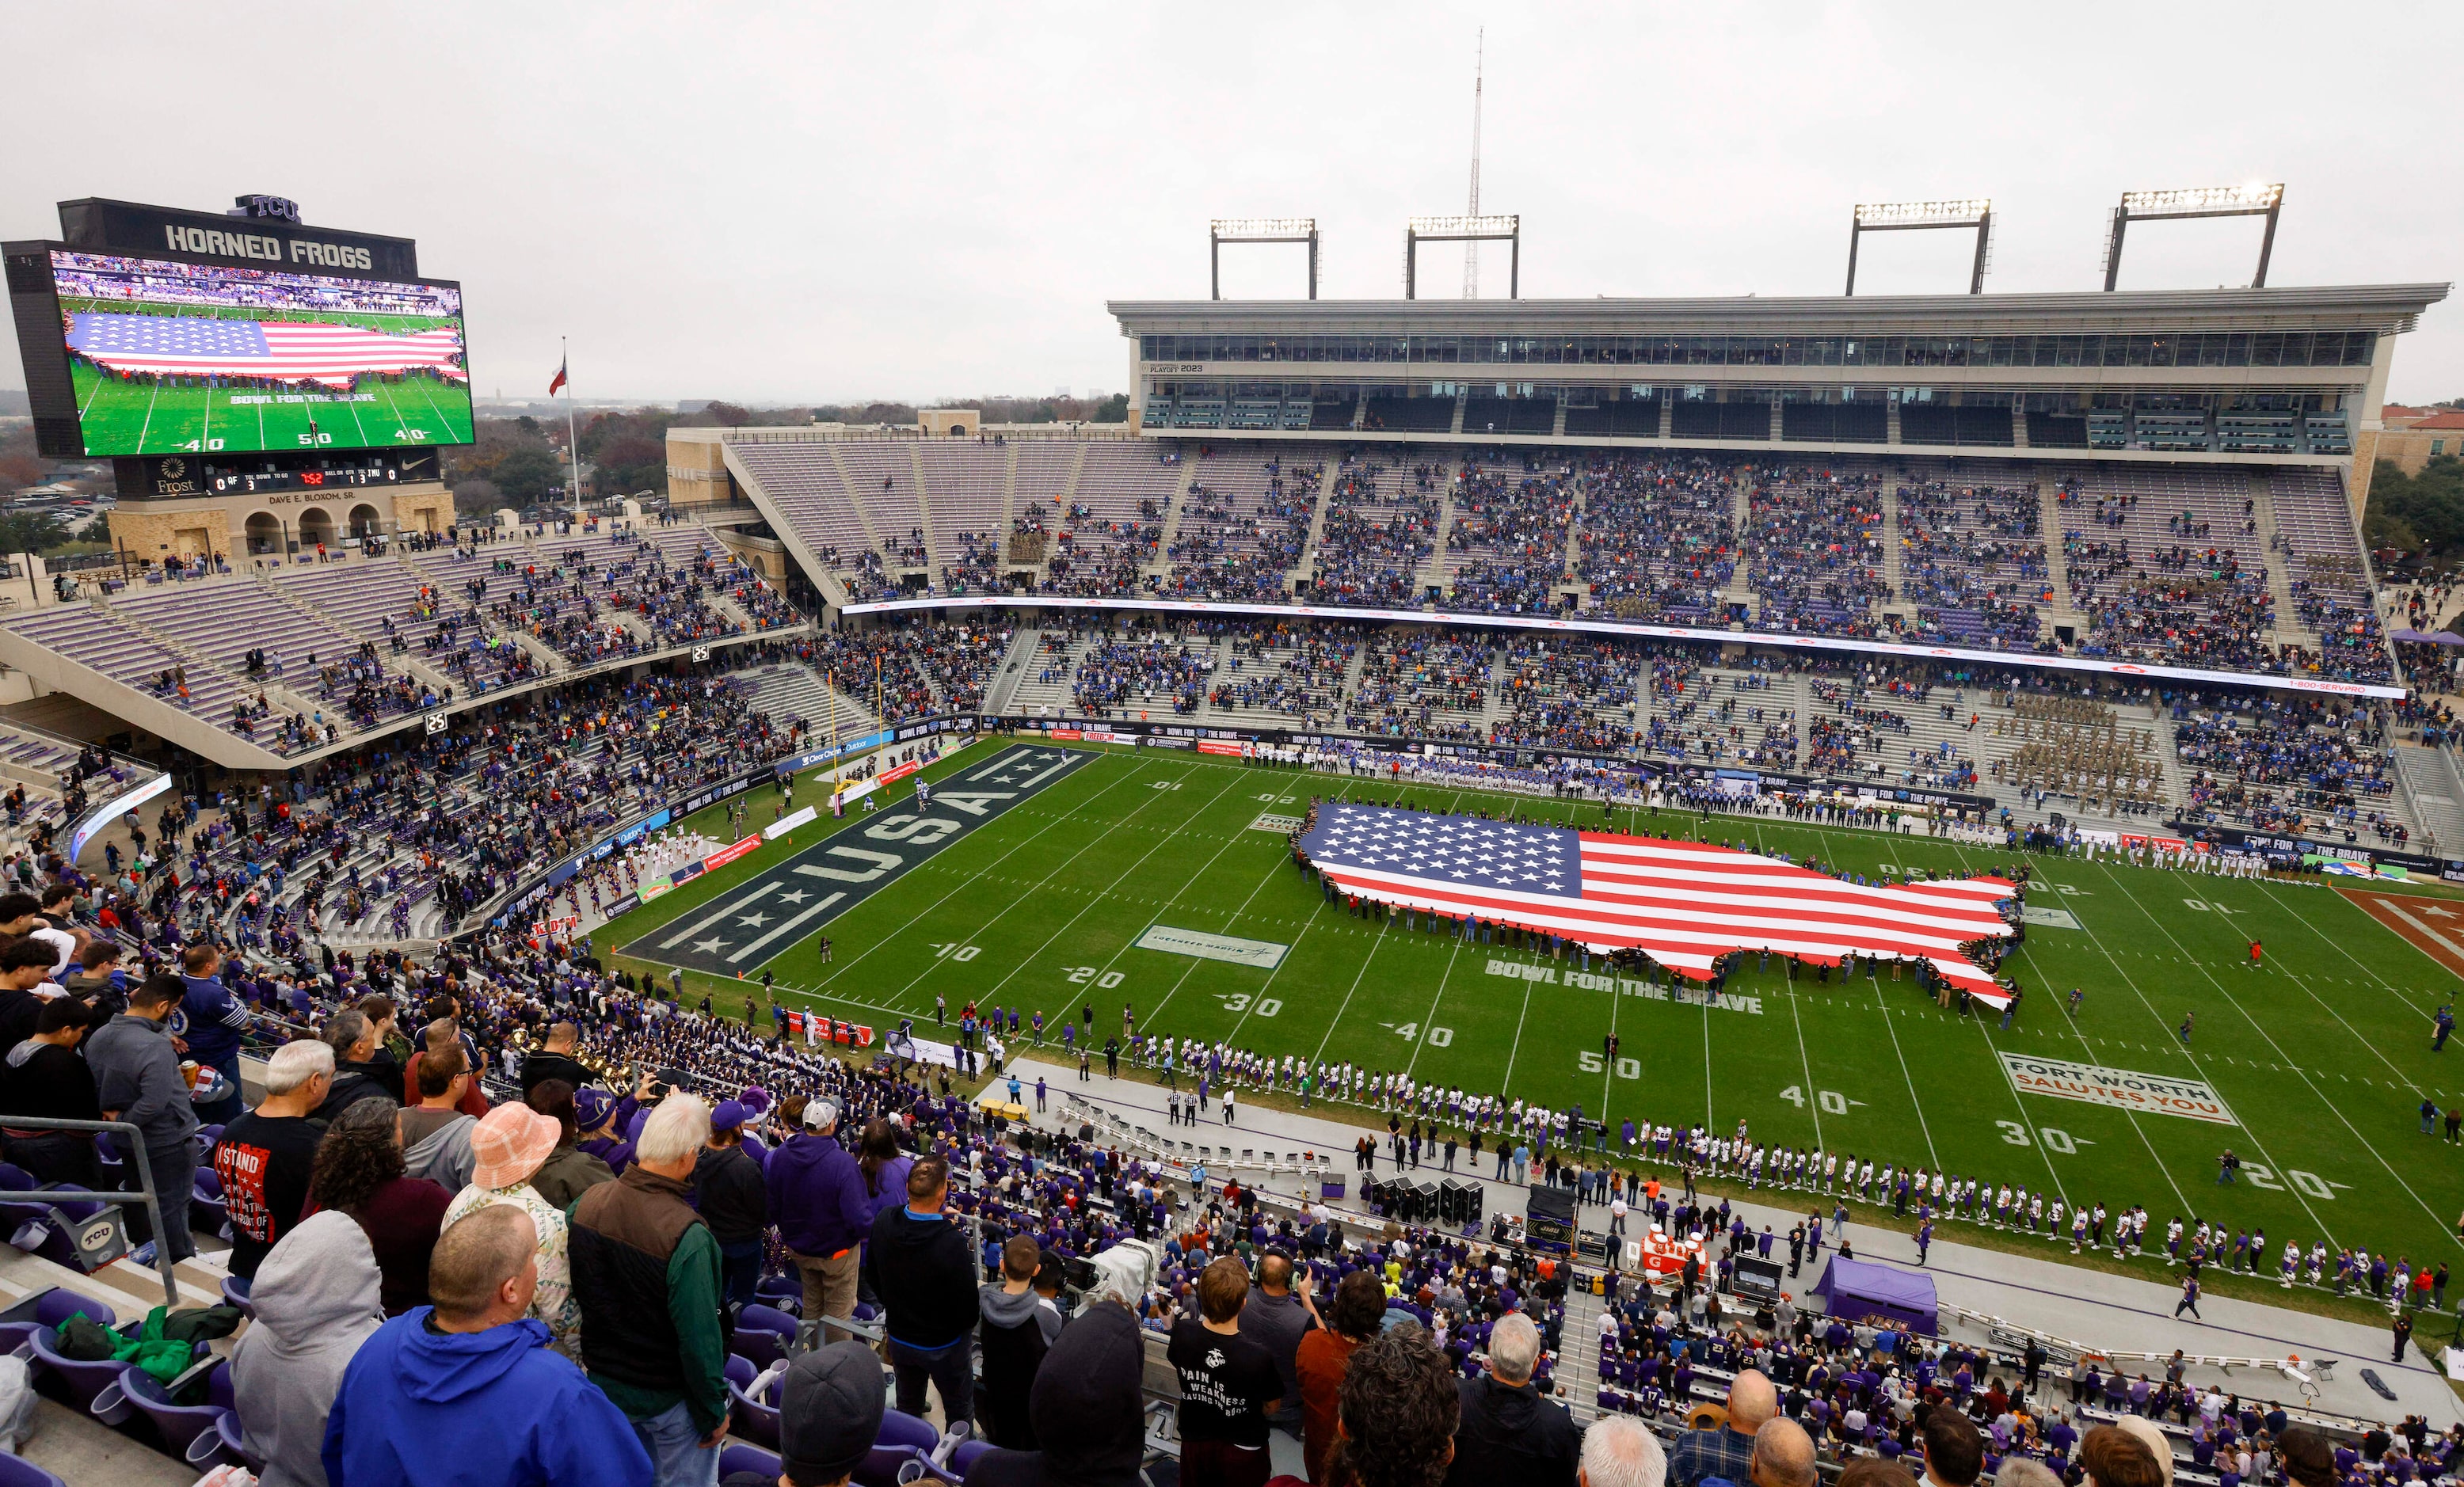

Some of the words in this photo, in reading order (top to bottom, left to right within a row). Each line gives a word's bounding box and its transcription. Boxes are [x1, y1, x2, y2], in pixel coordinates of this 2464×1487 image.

[253, 196, 299, 222] TCU
[166, 225, 281, 261] HORNED
[289, 239, 372, 270] FROGS
[230, 395, 274, 405] BOWL
[277, 394, 306, 403] FOR
[307, 394, 333, 403] THE
[298, 432, 333, 446] 50
[394, 428, 425, 440] 40
[185, 439, 225, 452] 40
[301, 473, 323, 485] 7:52
[360, 475, 366, 484] 3
[367, 468, 380, 478] JMU
[388, 469, 396, 481] 0
[158, 479, 196, 493] Frost
[215, 478, 226, 491] 0
[227, 475, 238, 486] AF
[248, 481, 255, 491] 3
[269, 495, 291, 505] DAVE
[294, 494, 303, 503] E.
[304, 492, 341, 503] BLOXOM,
[343, 491, 356, 500] SR.
[695, 645, 708, 660] 25
[2288, 679, 2366, 694] 1-800-SERVPRO
[428, 716, 445, 731] 25
[899, 728, 916, 740] BOWL
[916, 724, 927, 736] FOR
[939, 720, 951, 730] THE
[1058, 721, 1070, 730] FOR
[1082, 722, 1094, 731] THE
[1093, 723, 1112, 732] BRAVE
[1167, 727, 1184, 736] BOWL
[1183, 728, 1195, 737] FOR
[1208, 729, 1220, 738] THE
[1218, 731, 1238, 740] BRAVE
[1292, 735, 1310, 744] BOWL
[1310, 736, 1322, 745] FOR
[1156, 738, 1190, 747] CROSSCOUNTRY
[809, 752, 825, 763] Clear
[845, 740, 867, 751] Outdoor
[1442, 746, 1454, 755] FOR
[1580, 759, 1593, 767] FOR
[1152, 781, 1183, 790] 10
[1765, 777, 1789, 787] BRAVE
[687, 801, 703, 812] BOWL
[702, 793, 713, 805] FOR
[722, 786, 733, 797] THE
[732, 778, 748, 790] BRAVE
[1257, 793, 1297, 804] 20
[1878, 789, 1894, 800] FOR
[1910, 793, 1924, 803] THE
[620, 827, 642, 843] Outdoor
[792, 792, 1019, 884] USA
[707, 856, 722, 866] Armed
[720, 849, 735, 860] Forces
[734, 840, 752, 853] Insurance
[2273, 839, 2294, 851] FOR
[2316, 845, 2336, 857] THE
[2336, 848, 2371, 862] BRAVE
[516, 895, 528, 913] THE
[2183, 899, 2238, 915] 10
[1153, 935, 1203, 947] LOCKHEED
[1205, 943, 1244, 954] MARTIN
[934, 942, 981, 963] 10
[1066, 966, 1125, 990] 20
[1485, 958, 1558, 985] BOWL
[1563, 970, 1616, 994] FOR
[1620, 978, 1669, 1002] THE
[1674, 987, 1764, 1016] BRAVE
[1223, 993, 1284, 1018] 30
[1394, 1021, 1456, 1048] 40
[1578, 1050, 1643, 1080] 50
[2010, 1061, 2085, 1082] FORT
[2092, 1074, 2212, 1101] WORTH
[1779, 1085, 1849, 1115] 40
[2016, 1074, 2146, 1104] SALUTES
[2150, 1094, 2220, 1114] YOU
[1994, 1120, 2078, 1155] 30
[218, 1147, 223, 1163] I
[223, 1147, 259, 1174] STAND
[2238, 1160, 2337, 1200] 20
[256, 1215, 268, 1227] OF
[85, 1226, 110, 1246] TCU
[1540, 1225, 1560, 1234] JMU
[1648, 1256, 1662, 1268] G
[1712, 1342, 1724, 1353] 23
[1805, 1347, 1814, 1356] 18
[1910, 1347, 1921, 1356] 20
[1742, 1356, 1754, 1366] 23
[1180, 1367, 1209, 1384] PAIN
[1214, 1380, 1224, 1393] IS
[1928, 1369, 1934, 1378] 0
[1182, 1391, 1213, 1405] EAVING
[1214, 1399, 1224, 1411] THE
[1190, 1382, 1247, 1407] WEAKNESS
[1647, 1391, 1658, 1401] 17
